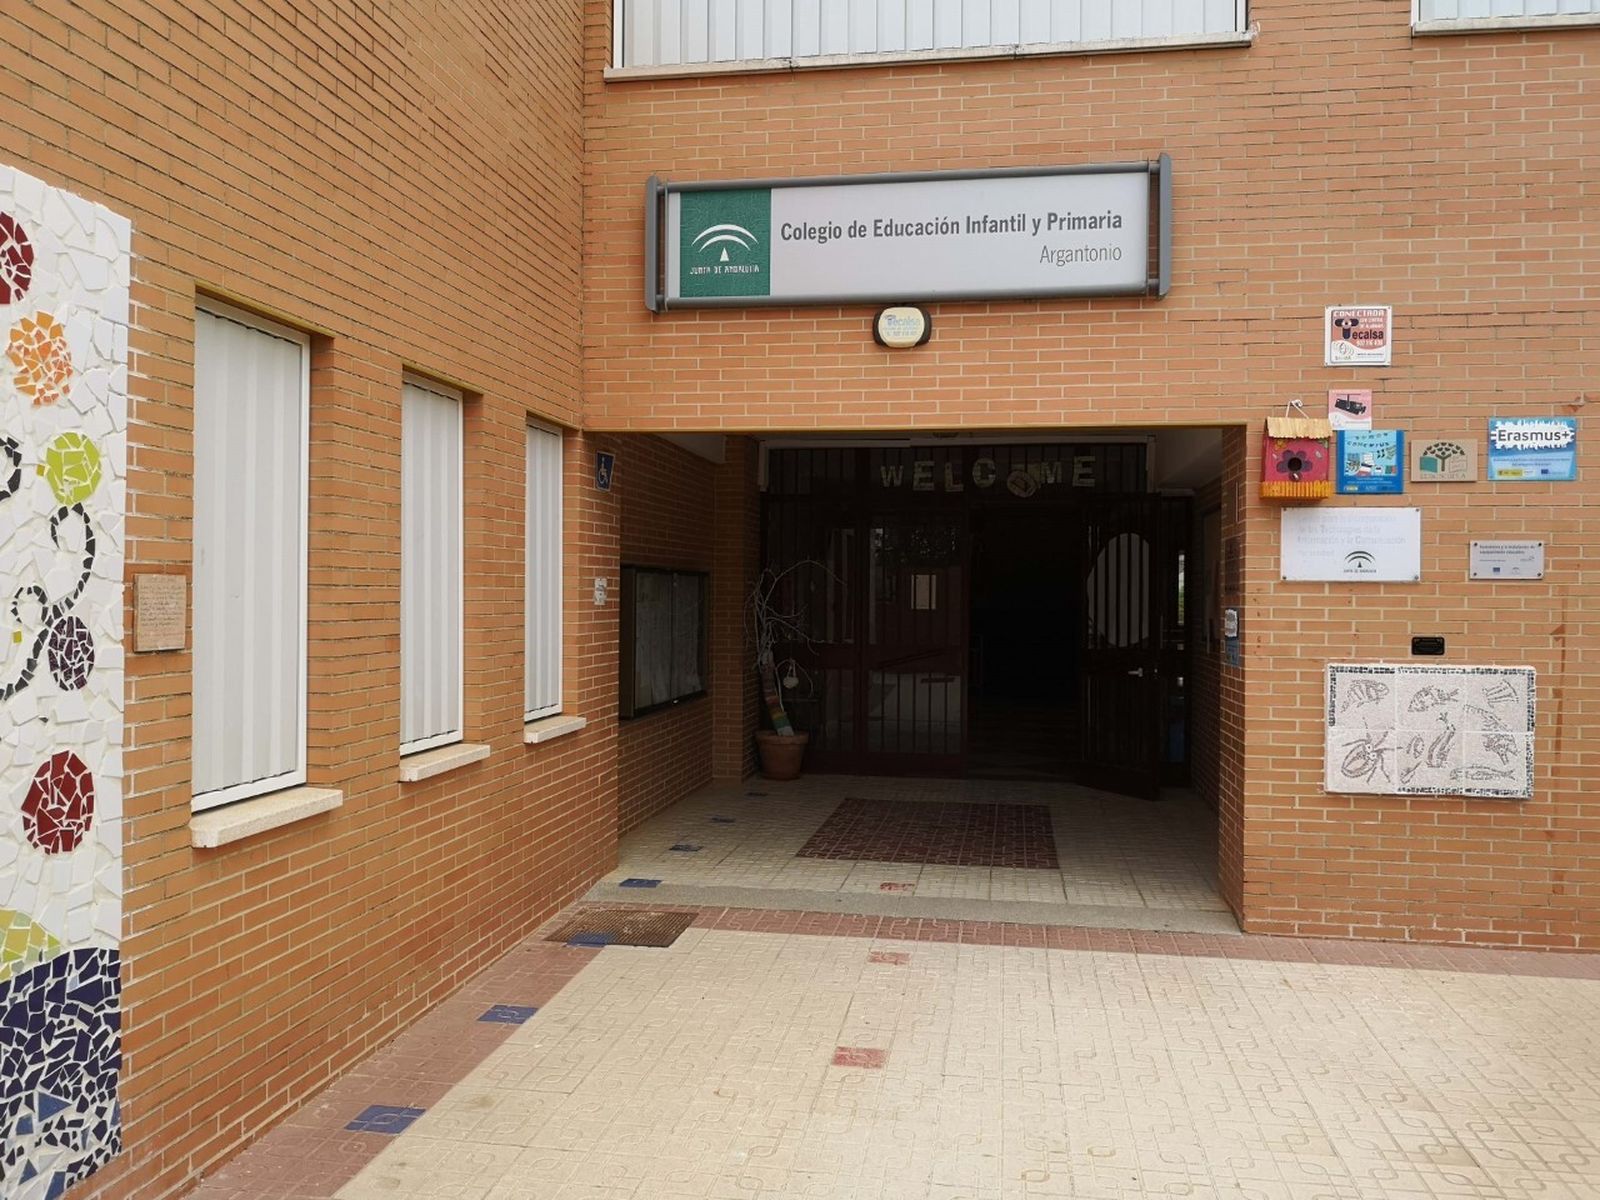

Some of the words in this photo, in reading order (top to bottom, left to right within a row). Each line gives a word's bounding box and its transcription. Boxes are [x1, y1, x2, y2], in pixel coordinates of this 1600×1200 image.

[781, 221, 842, 244] Colegio
[848, 220, 867, 238] de
[873, 216, 960, 237] Educación
[966, 213, 1026, 234] Infantil
[1032, 217, 1041, 236] y
[1047, 210, 1122, 231] Primaria
[1040, 243, 1122, 267] Argantonio
[1498, 429, 1570, 441] Erasmus+
